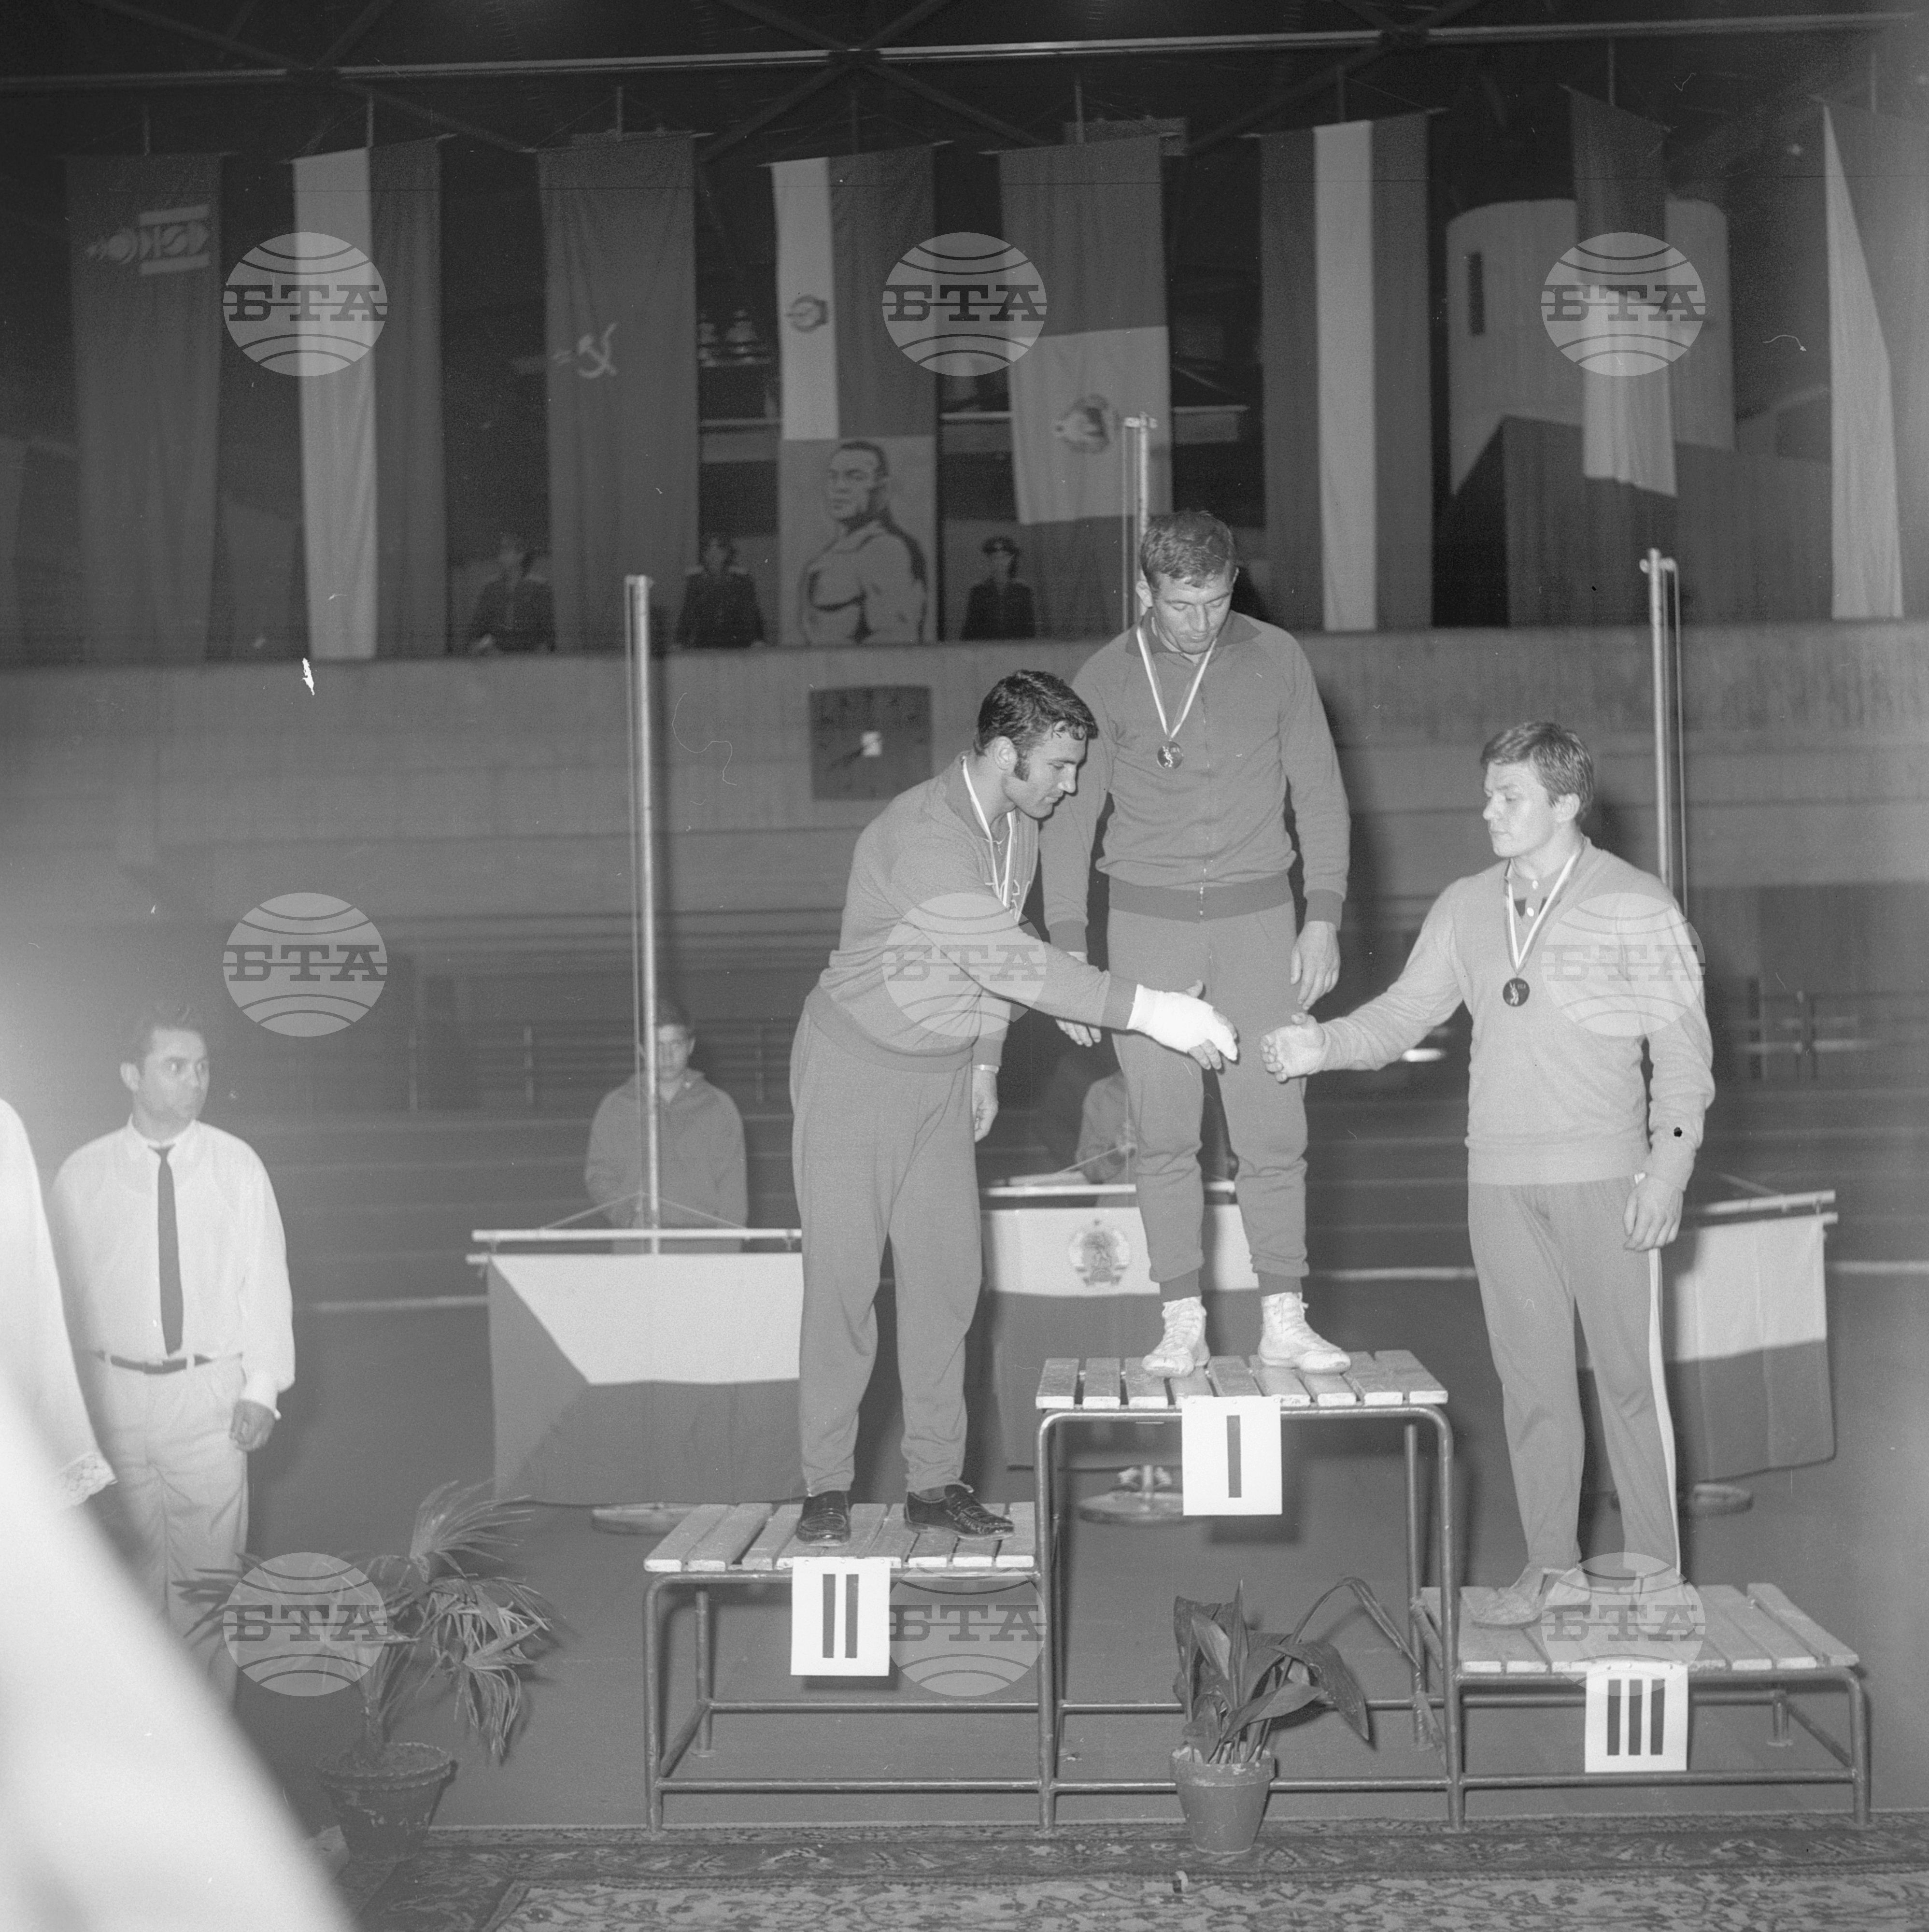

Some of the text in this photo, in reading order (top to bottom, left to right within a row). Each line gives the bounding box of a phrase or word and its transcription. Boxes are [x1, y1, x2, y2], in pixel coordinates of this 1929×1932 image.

[1226, 1415, 1242, 1498] I
[822, 1573, 859, 1659] II
[1607, 1678, 1665, 1756] III
